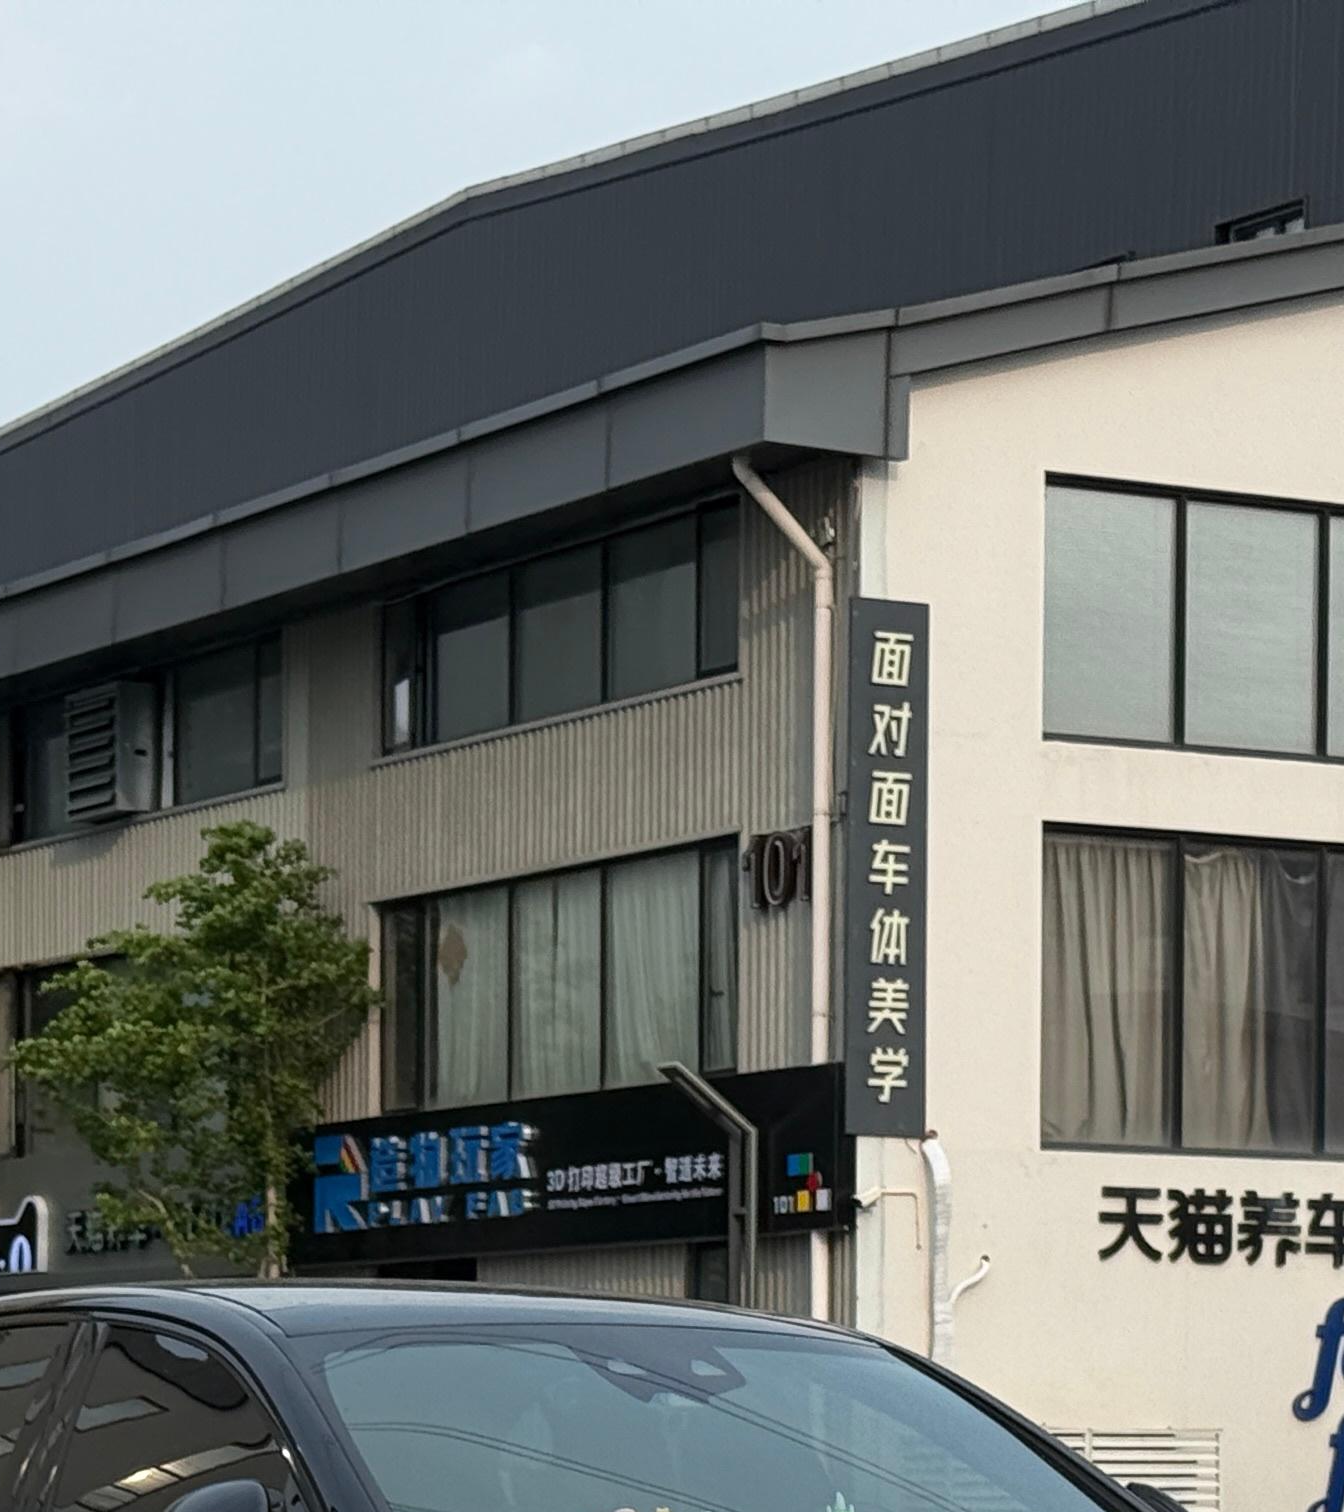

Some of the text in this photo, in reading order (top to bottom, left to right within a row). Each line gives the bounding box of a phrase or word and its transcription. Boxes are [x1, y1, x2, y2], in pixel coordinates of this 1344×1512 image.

[867, 630, 914, 1104] 面对面车体美学
